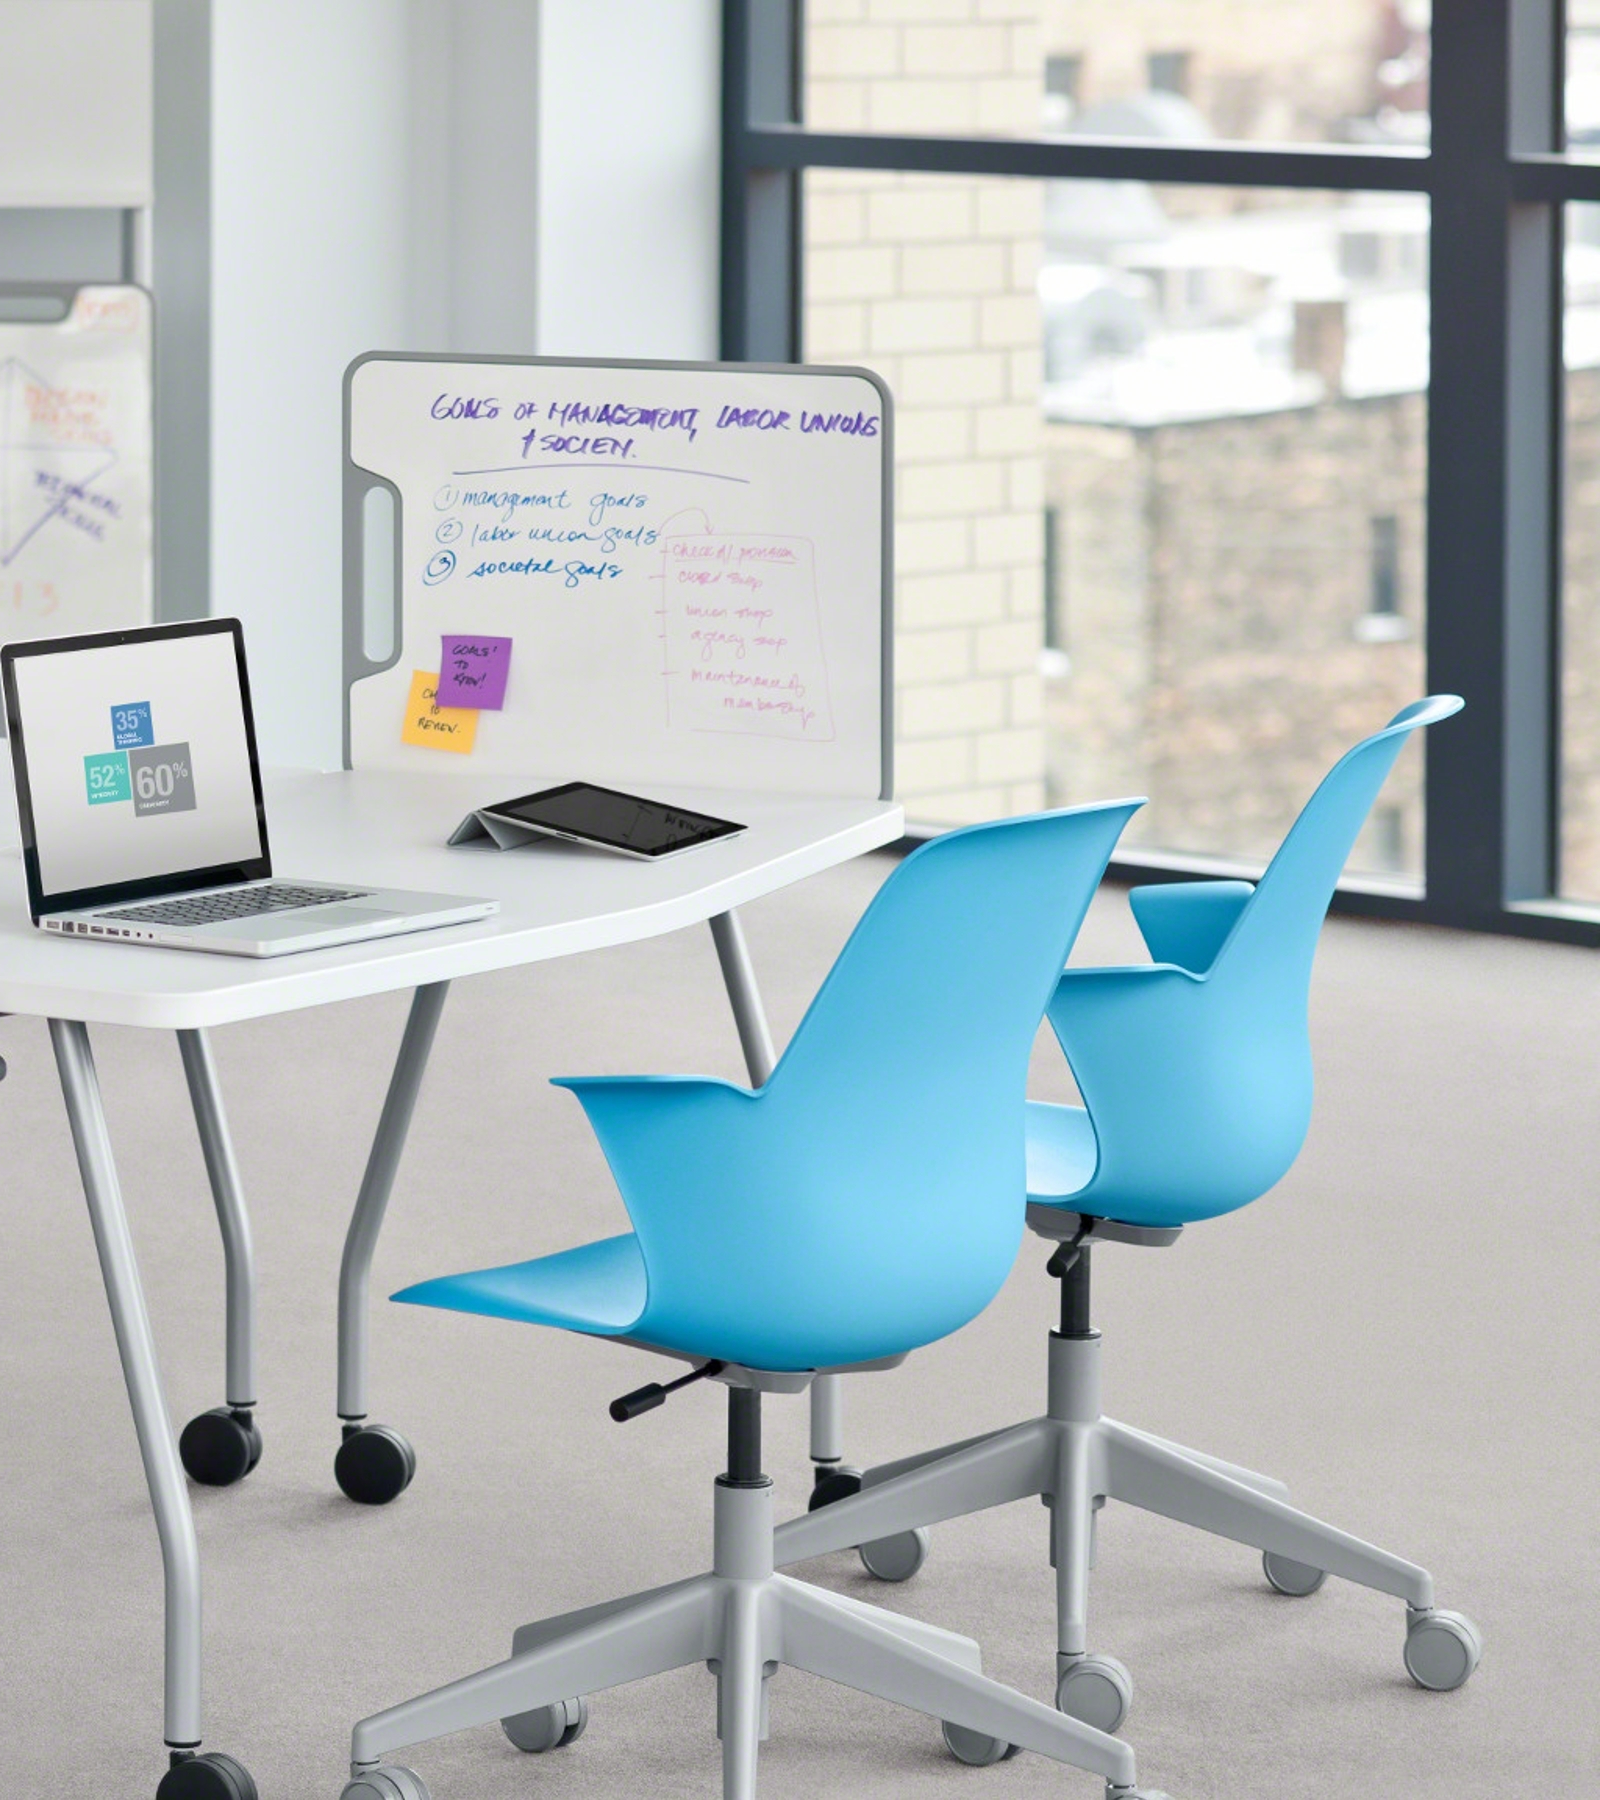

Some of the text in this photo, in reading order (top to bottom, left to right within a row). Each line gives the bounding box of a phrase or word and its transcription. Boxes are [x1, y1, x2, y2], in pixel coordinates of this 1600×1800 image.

[514, 402, 538, 420] OF
[589, 491, 648, 526] goals
[600, 525, 660, 554] goals
[561, 560, 623, 588] goals
[115, 707, 148, 732] 35%
[89, 763, 125, 789] 52%
[136, 761, 188, 800] 60%
